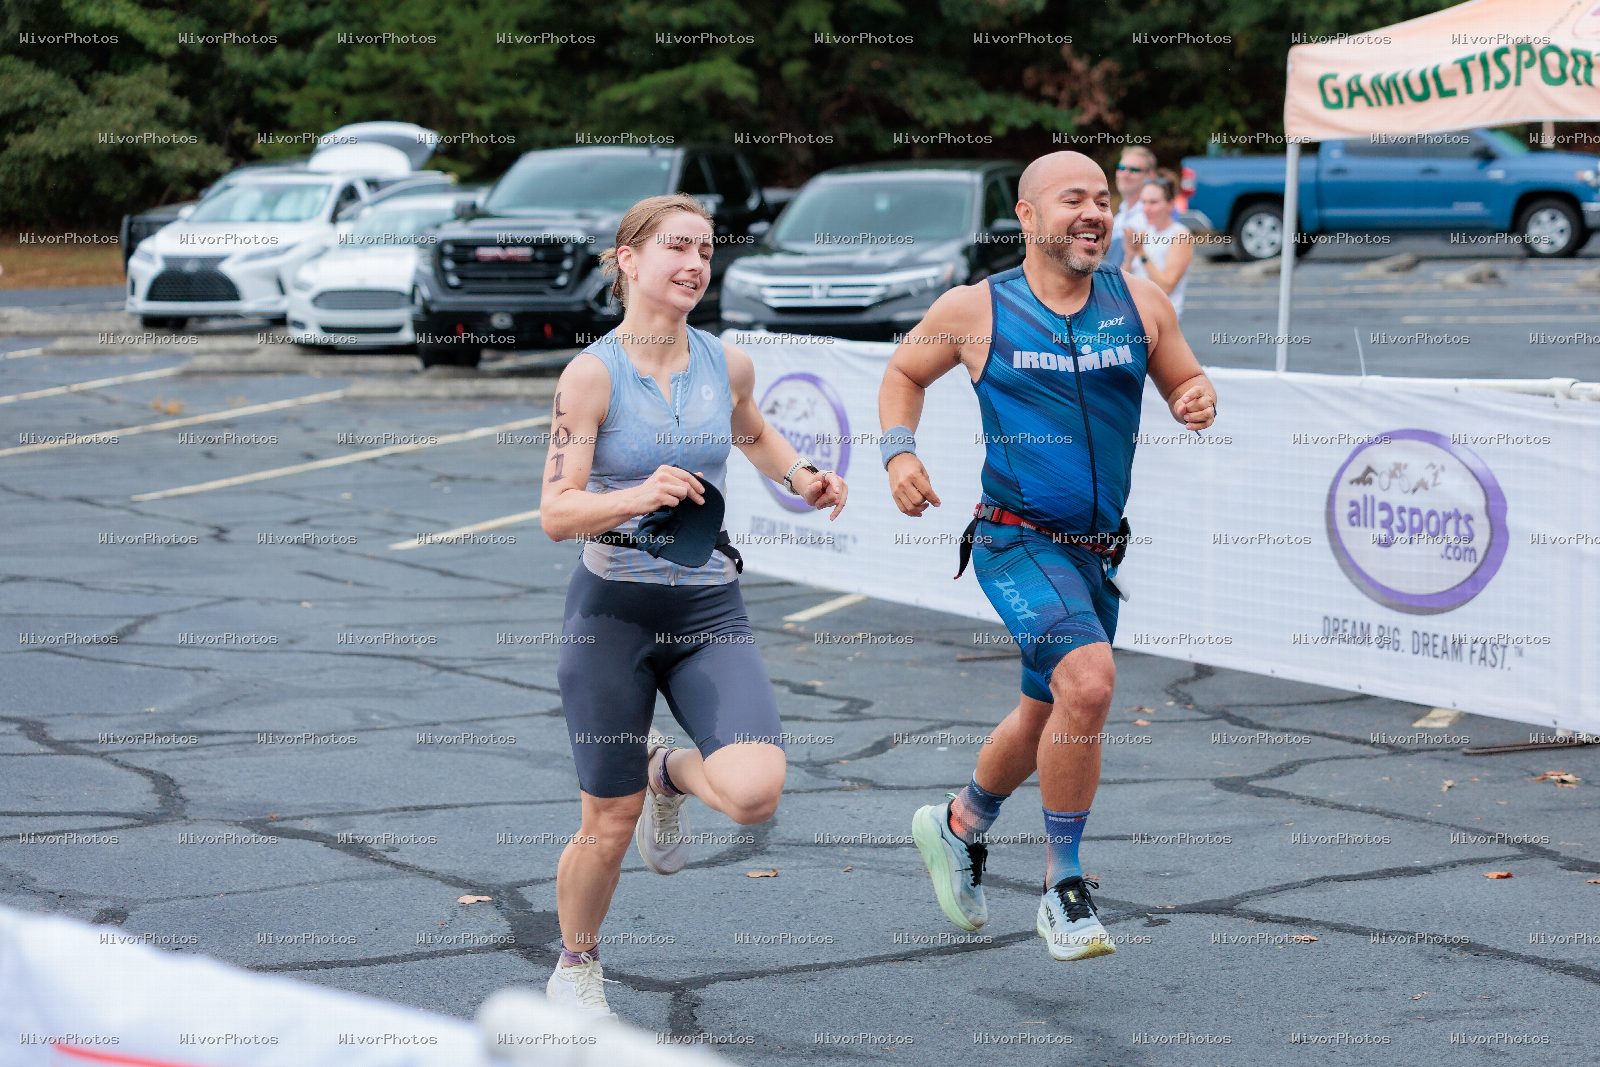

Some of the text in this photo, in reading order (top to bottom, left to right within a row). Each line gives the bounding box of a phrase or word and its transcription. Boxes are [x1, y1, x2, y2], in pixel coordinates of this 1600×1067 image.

[1318, 43, 1600, 110] GAMULTISPOR
[1013, 344, 1133, 373] IRONMAN
[1347, 494, 1475, 548] all3sports
[1322, 615, 1372, 647] DREAM
[1377, 624, 1405, 653] BIG.
[1411, 630, 1463, 662] DREAM
